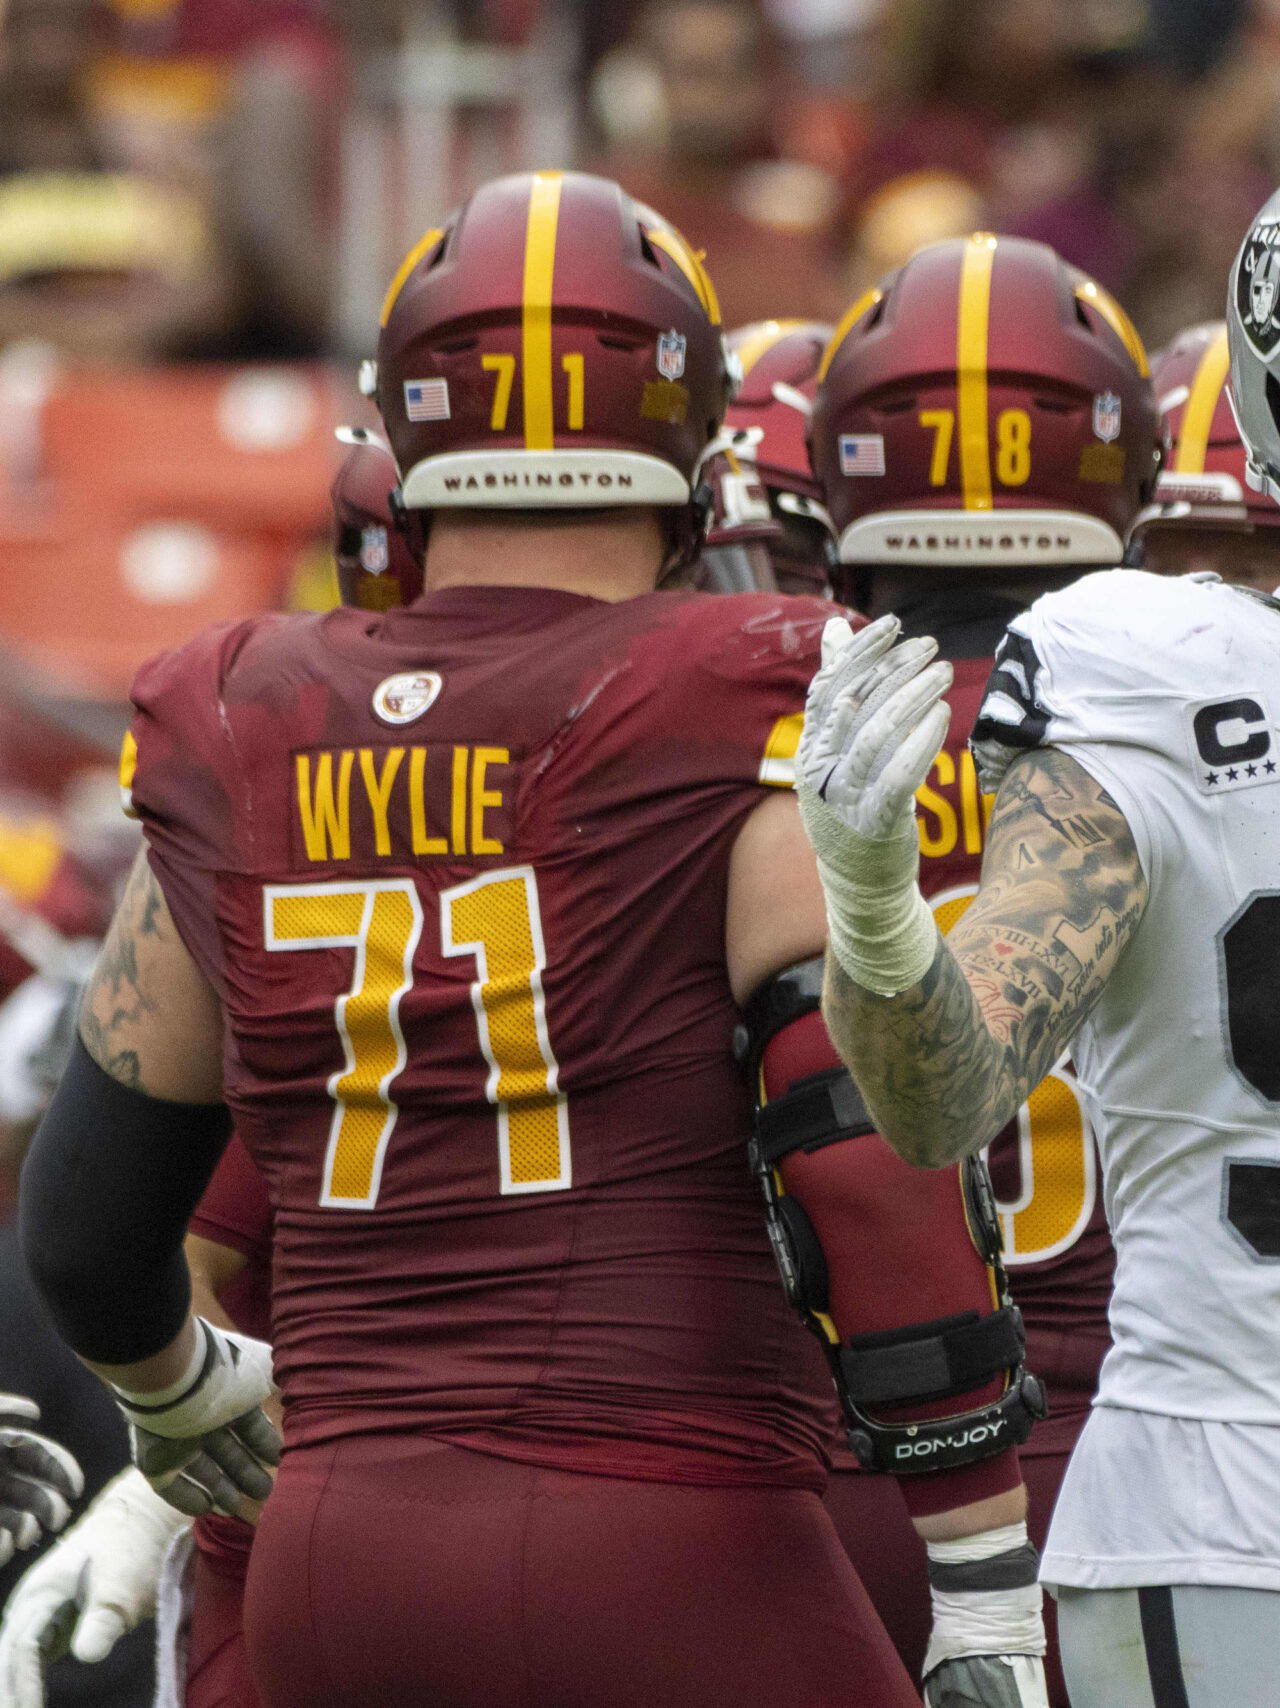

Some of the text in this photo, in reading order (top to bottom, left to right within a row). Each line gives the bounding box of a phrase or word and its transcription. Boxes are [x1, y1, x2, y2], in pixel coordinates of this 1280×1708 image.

[444, 472, 633, 491] WASHINGTON
[886, 535, 1071, 550] WASHINGTON
[1193, 697, 1272, 765] C
[296, 746, 510, 862] WYLIE
[262, 865, 572, 1211] 71
